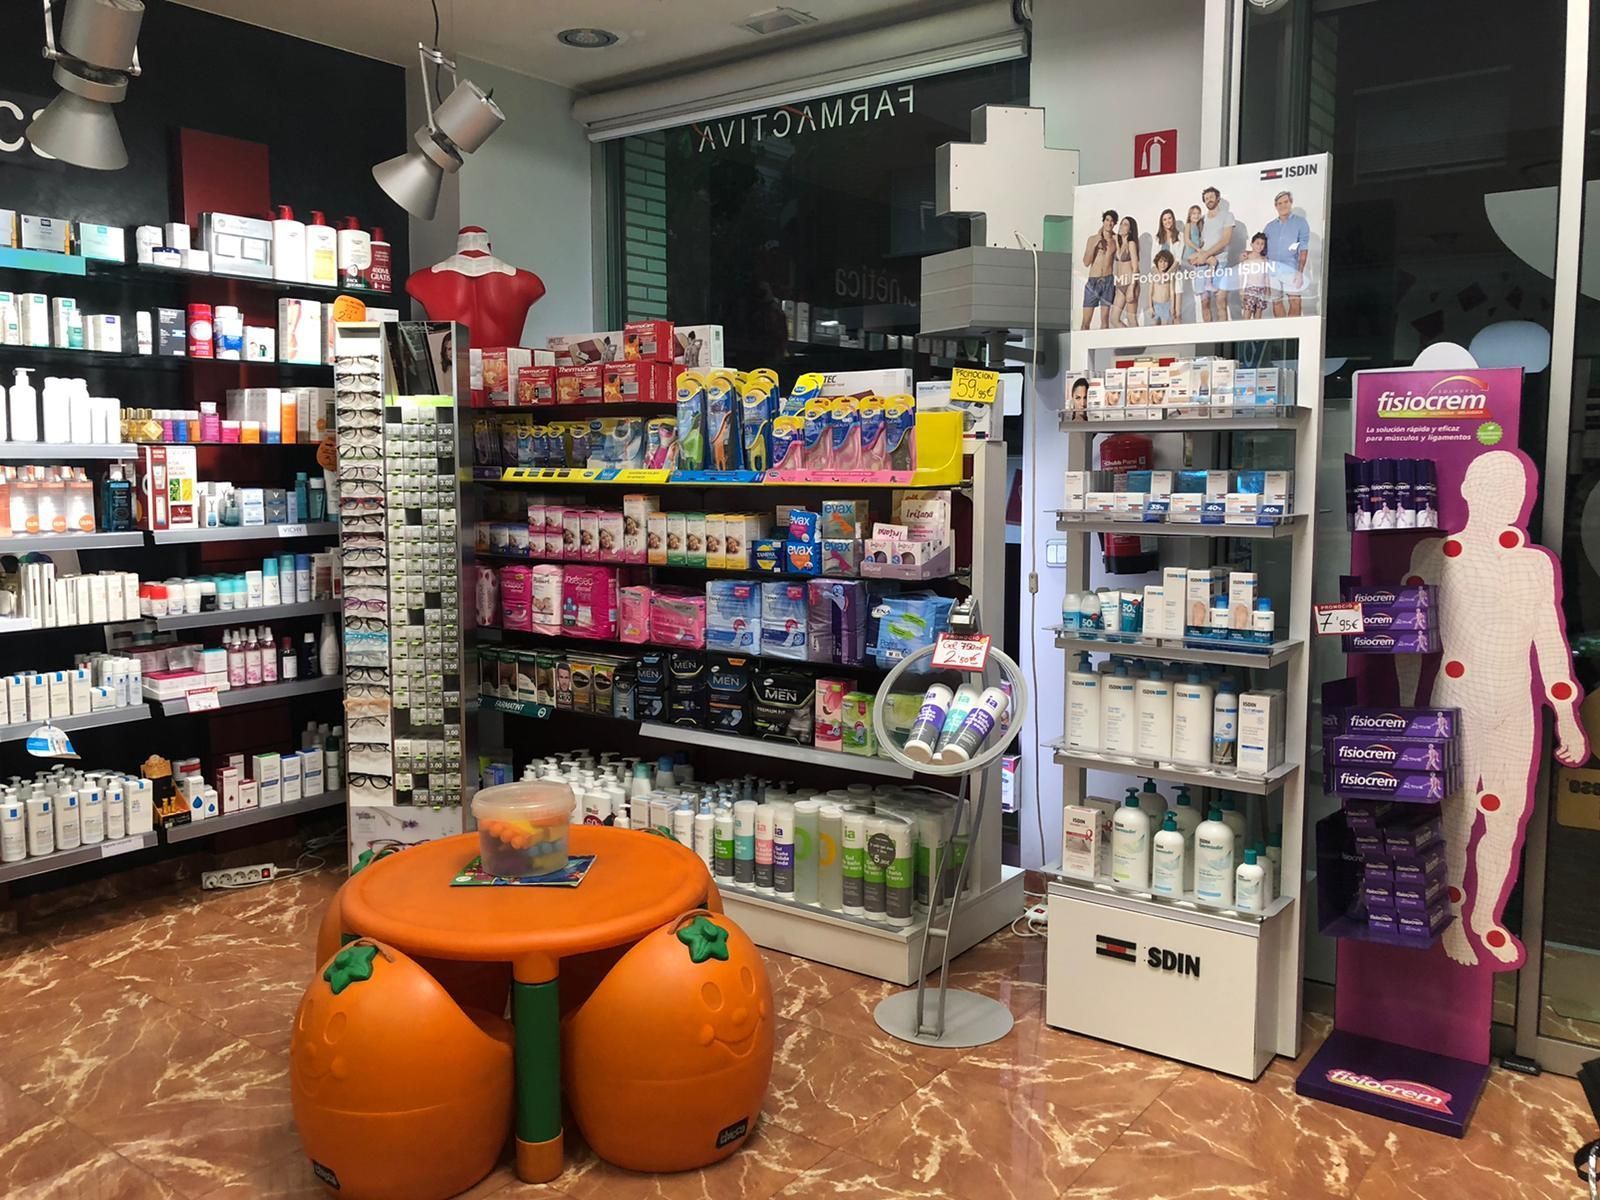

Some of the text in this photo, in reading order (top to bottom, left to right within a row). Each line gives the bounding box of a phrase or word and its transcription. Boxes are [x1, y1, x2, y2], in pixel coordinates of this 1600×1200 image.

[1285, 163, 1318, 178] ISDIN
[1114, 261, 1276, 287] Mi Fotoprotección ISDIN
[823, 375, 837, 383] TEC
[1377, 391, 1487, 412] fisiocrem
[1376, 425, 1405, 433] solución
[1407, 425, 1430, 434] rápida
[1428, 434, 1471, 442] ligamentos
[824, 503, 852, 514] evax
[790, 515, 810, 526] evax
[787, 545, 813, 556] evax
[823, 541, 850, 552] evax
[1354, 593, 1395, 603] fisiocrem
[1319, 612, 1359, 632] 7'95€
[1363, 616, 1393, 624] ocrem
[1353, 637, 1395, 646] fisiocrem
[673, 661, 697, 669] MEN
[637, 670, 659, 678] MEN
[712, 676, 740, 686] MEN
[764, 689, 797, 702] MEN
[985, 695, 999, 709] ia
[1350, 715, 1406, 728] fisiocrem
[1338, 745, 1396, 760] fisiocrem
[1340, 772, 1398, 788] fisiocrem
[774, 824, 783, 836] ia
[844, 825, 856, 839] ia
[1330, 1070, 1442, 1105] fisiocrem
